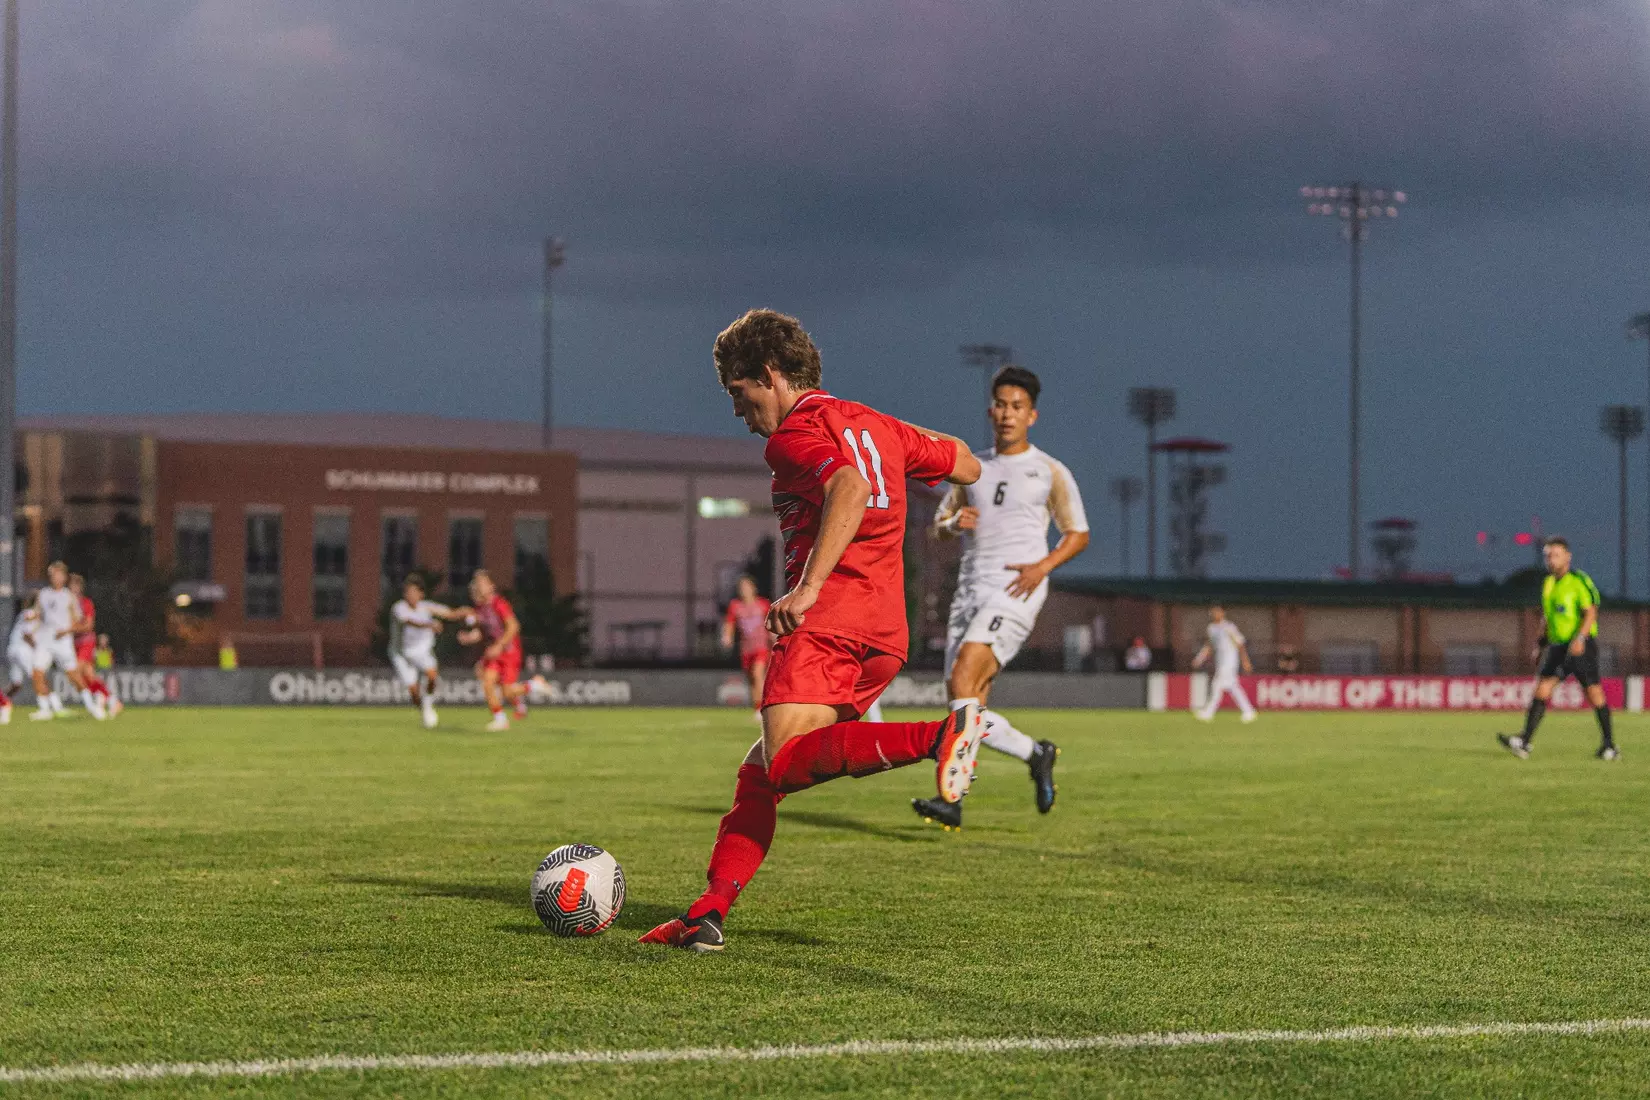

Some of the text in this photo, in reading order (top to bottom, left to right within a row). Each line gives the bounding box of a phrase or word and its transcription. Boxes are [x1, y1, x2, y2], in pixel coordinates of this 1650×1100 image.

[843, 427, 889, 509] 11
[993, 481, 1008, 506] 6
[989, 615, 1003, 631] 6
[1257, 678, 1341, 708] HOME
[1345, 678, 1386, 708] OF
[1389, 679, 1443, 708] THE
